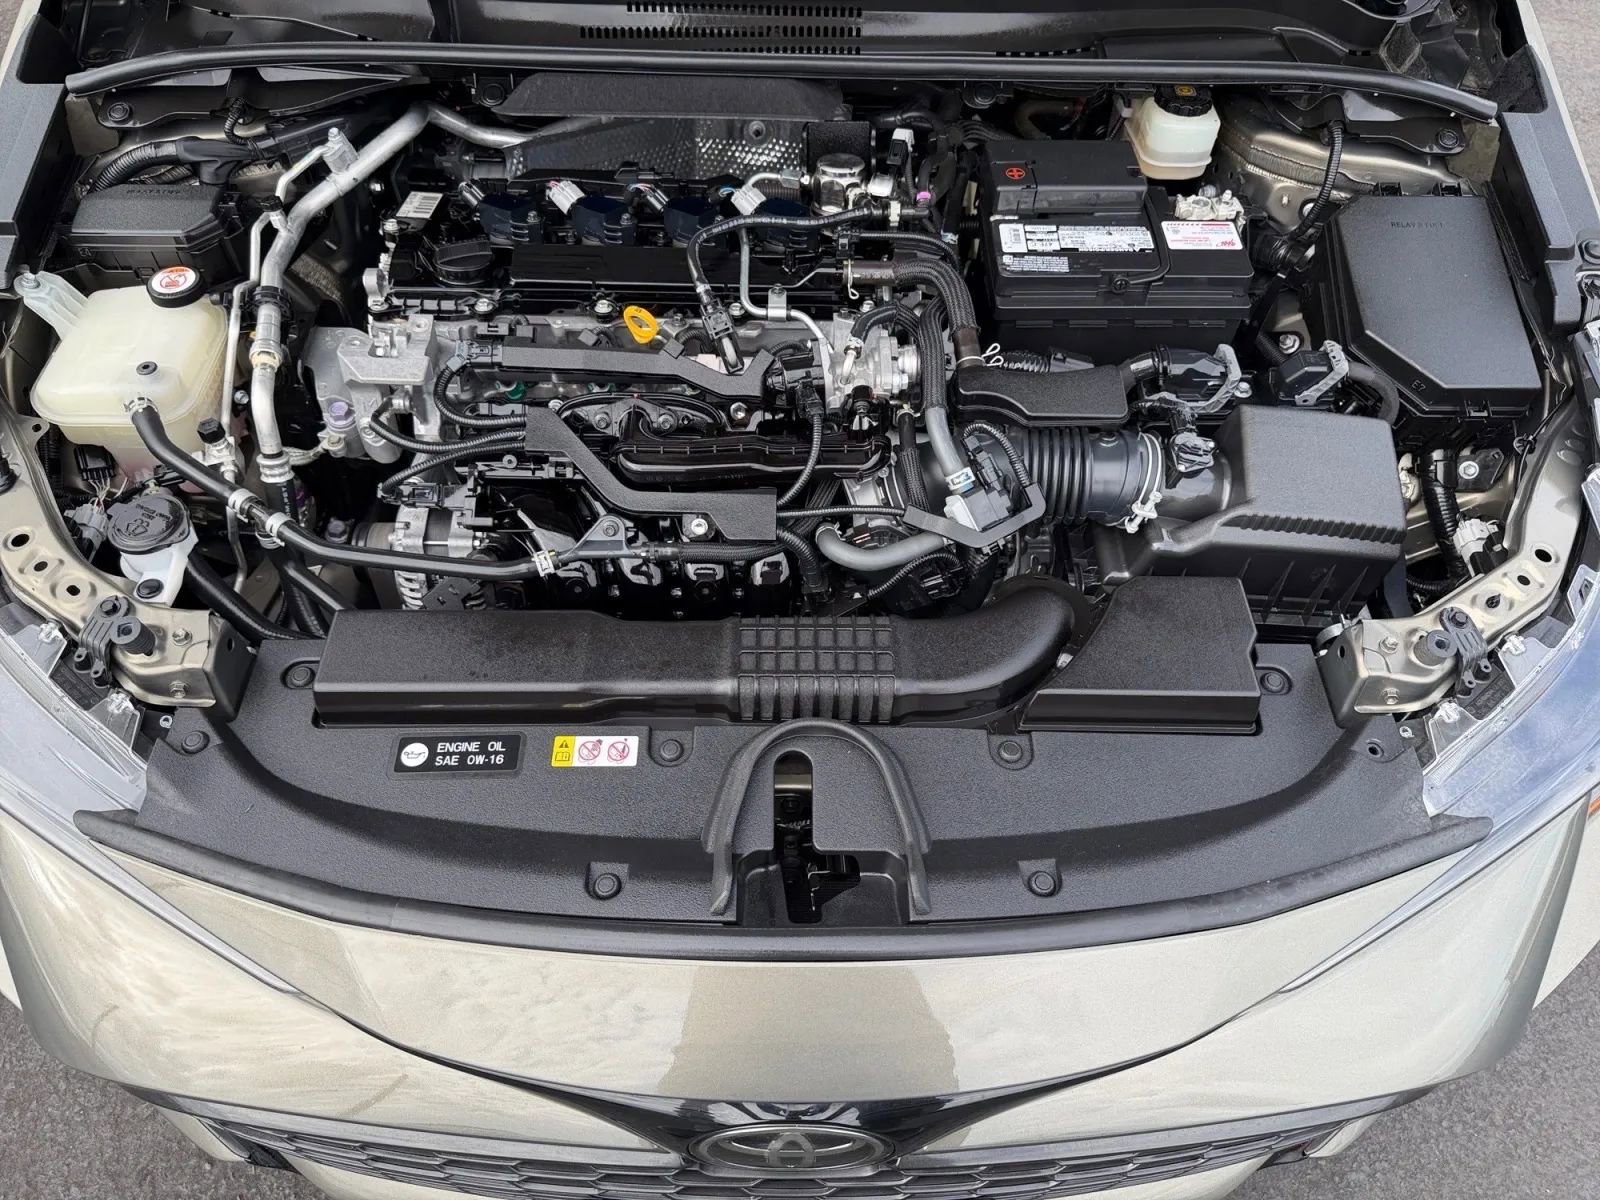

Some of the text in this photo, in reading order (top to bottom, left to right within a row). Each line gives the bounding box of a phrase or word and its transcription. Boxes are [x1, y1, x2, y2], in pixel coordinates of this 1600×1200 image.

[436, 741, 507, 753] ENGINE OIL
[434, 754, 505, 766] SAE 0W-16
